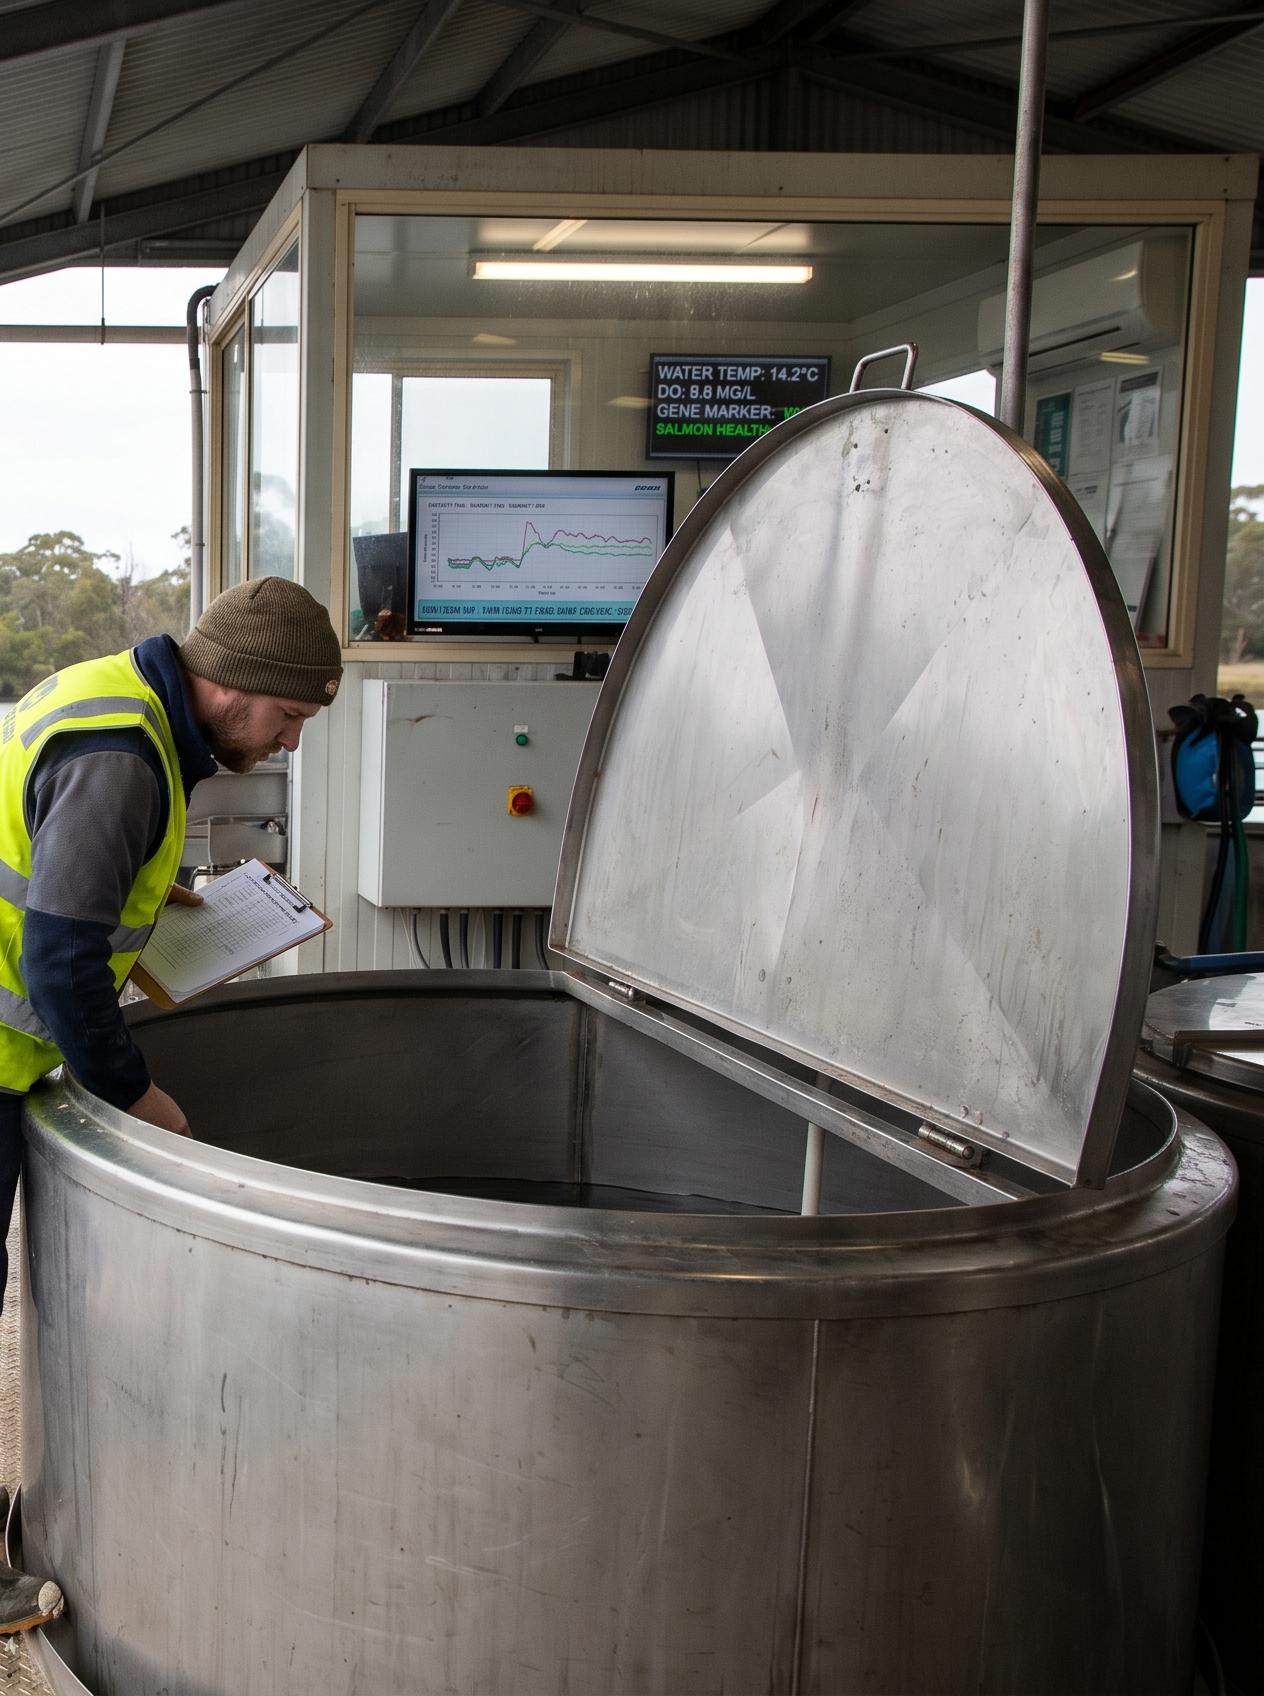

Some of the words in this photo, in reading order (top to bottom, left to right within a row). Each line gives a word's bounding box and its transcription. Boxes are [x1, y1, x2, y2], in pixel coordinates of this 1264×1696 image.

[658, 366, 713, 380] WATER
[718, 366, 765, 381] TEMP:
[770, 367, 819, 382] 14.2°C
[657, 384, 686, 399] DO:
[716, 386, 756, 400] MG/L
[657, 403, 701, 418] GENE
[704, 404, 775, 419] MARKER:
[656, 423, 713, 435] SALMON
